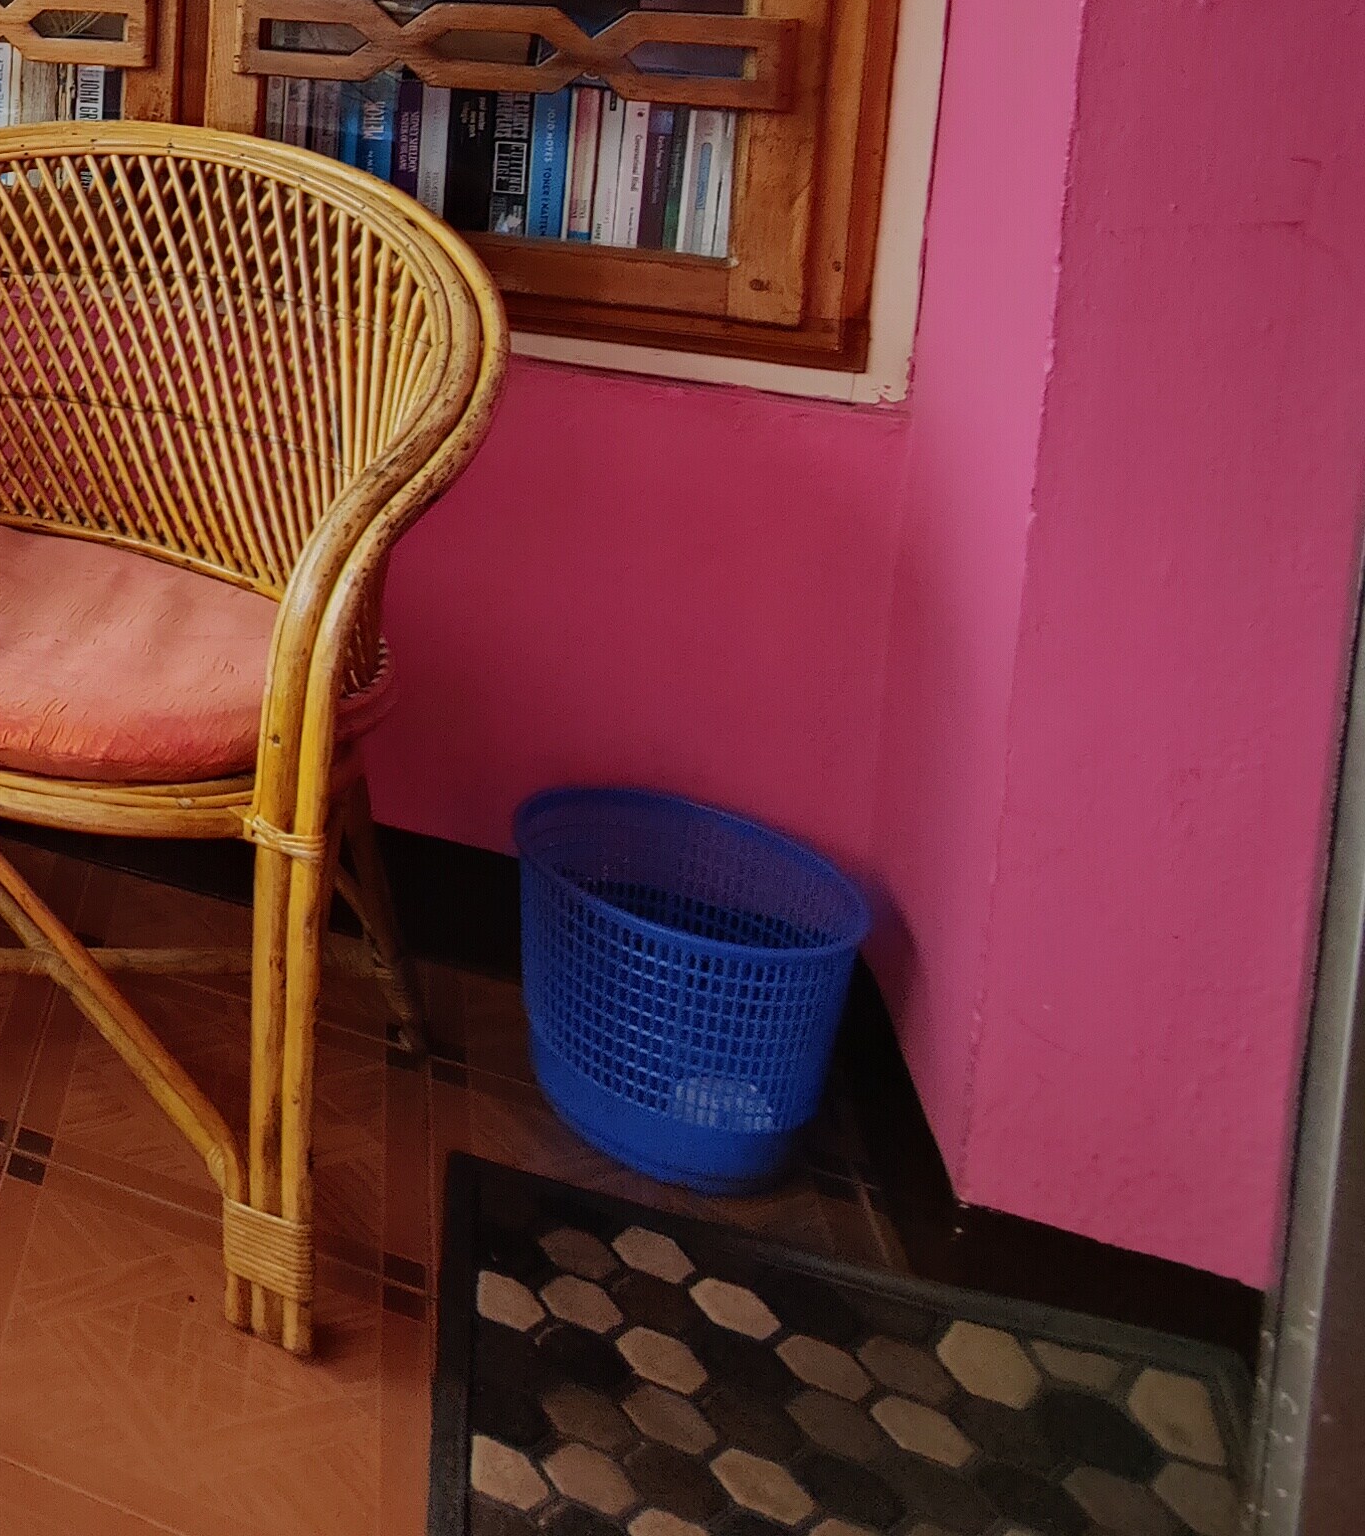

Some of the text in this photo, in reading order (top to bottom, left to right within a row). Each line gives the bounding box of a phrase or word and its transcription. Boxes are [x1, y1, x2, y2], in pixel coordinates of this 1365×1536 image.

[79, 76, 101, 104] JOHN
[363, 100, 387, 140] METEOR
[543, 108, 557, 163] JOJO MOYES
[407, 138, 419, 173] SHELDON
[496, 152, 510, 182] EDGE
[509, 144, 525, 193] CUTTING
[630, 134, 644, 192] Conversational Hindi
